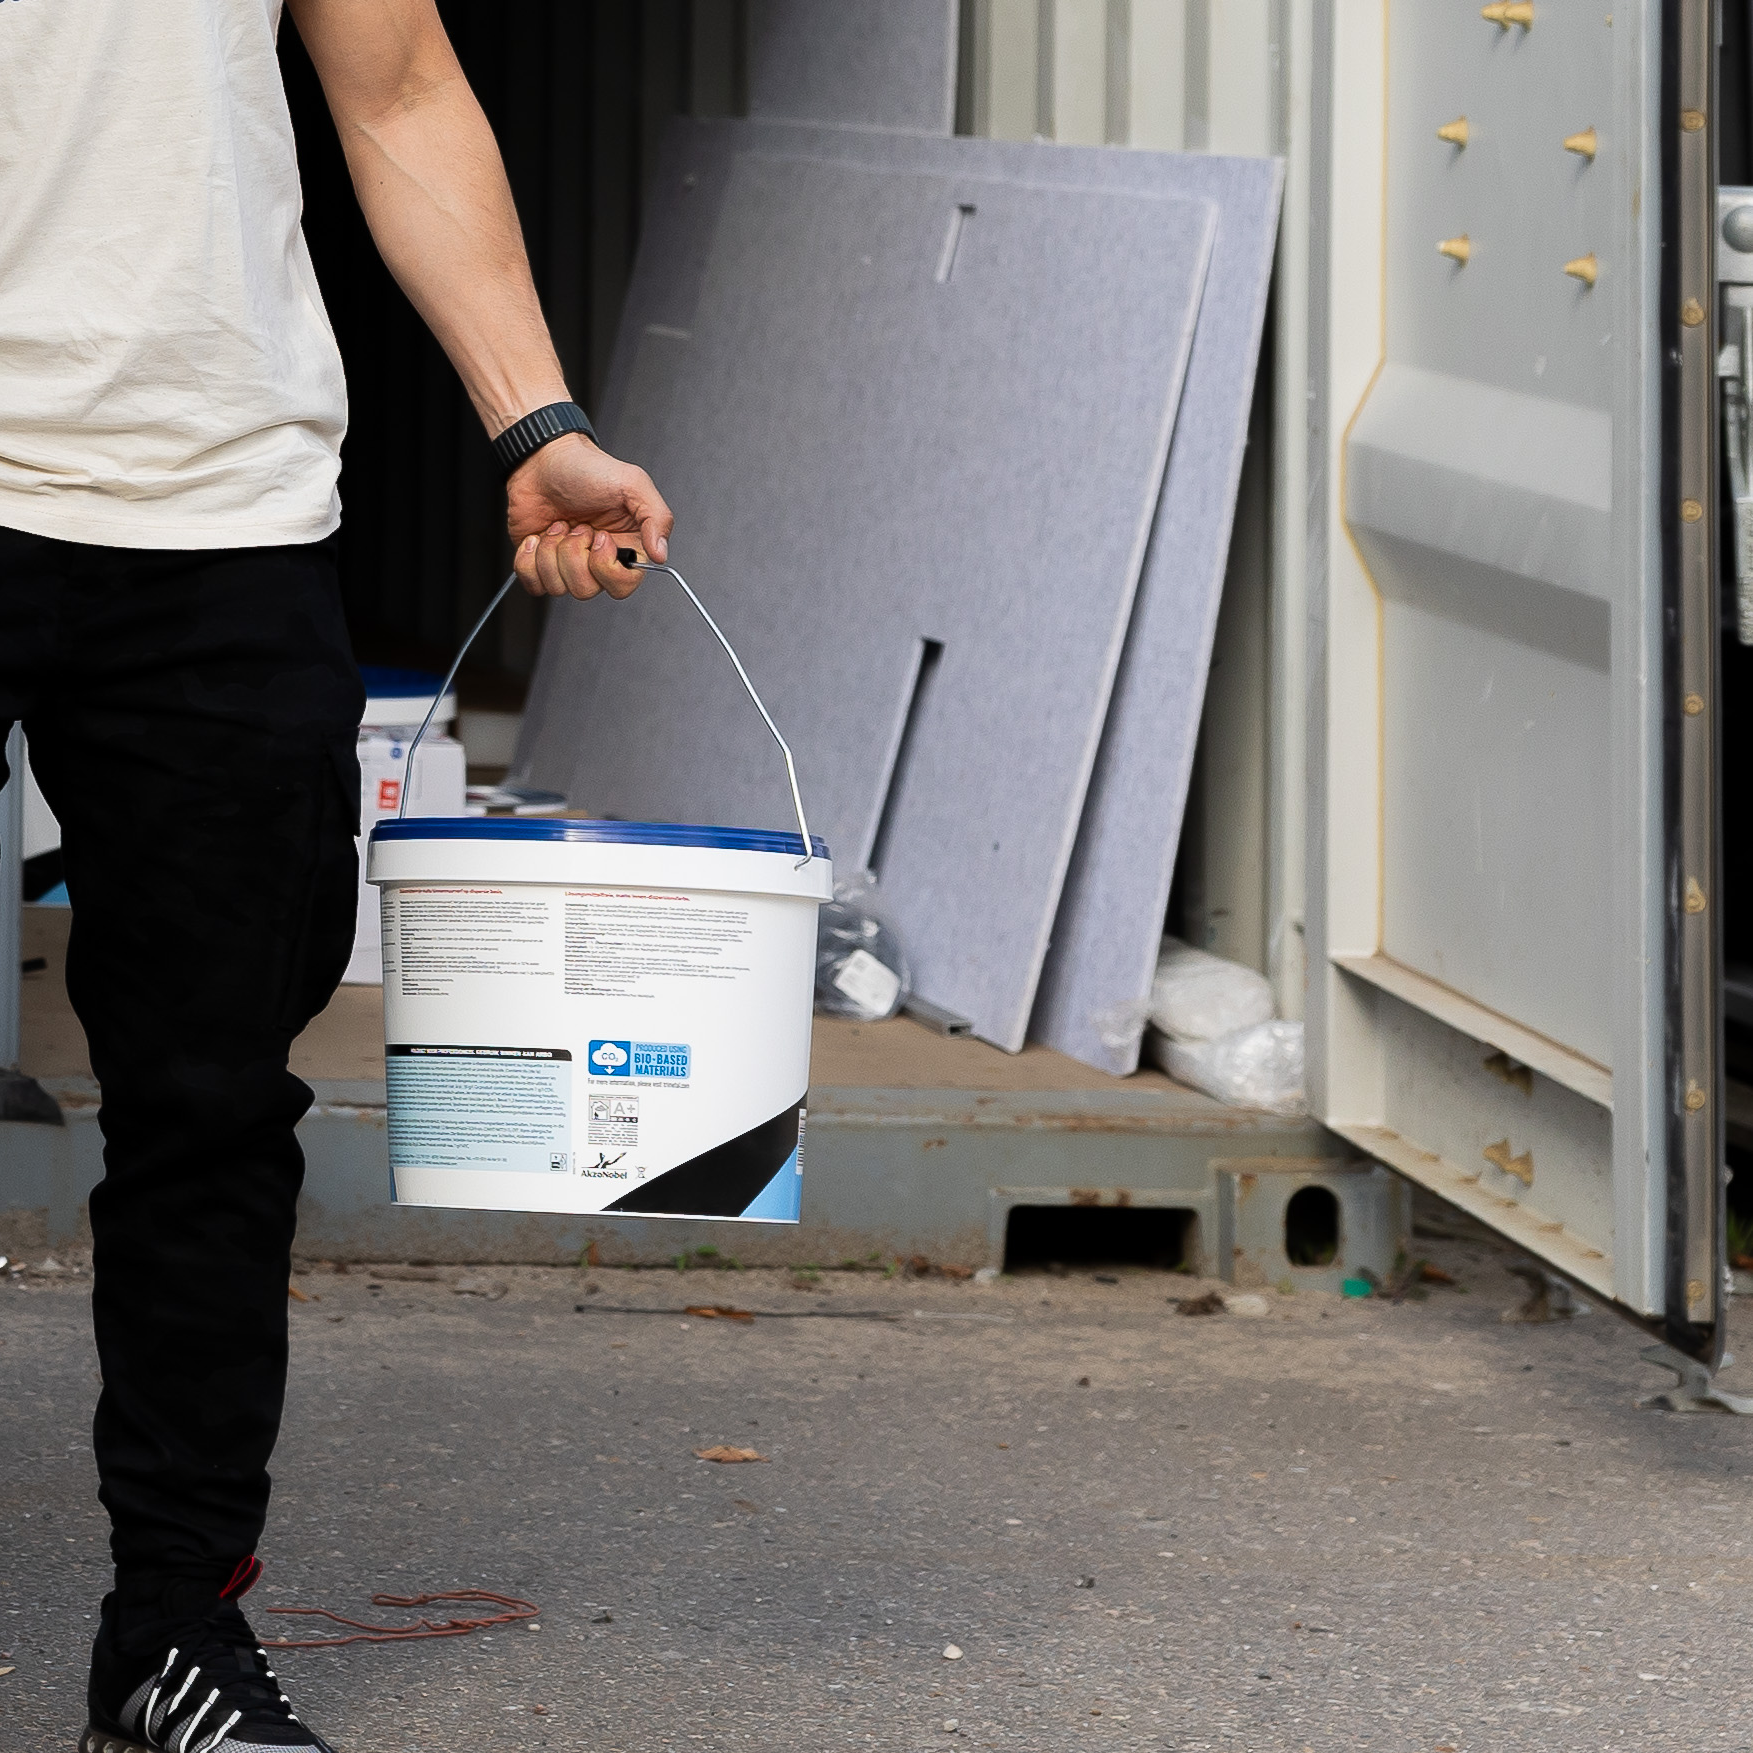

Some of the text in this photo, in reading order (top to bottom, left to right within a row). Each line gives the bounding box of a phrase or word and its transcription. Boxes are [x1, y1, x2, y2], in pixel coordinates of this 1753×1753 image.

[635, 1044, 688, 1054] PRODUCED USING
[635, 1053, 688, 1065] BIO-BASED
[635, 1066, 687, 1077] MATERIALS
[614, 1102, 636, 1115] A+
[581, 1169, 628, 1180] AkzoNobel
